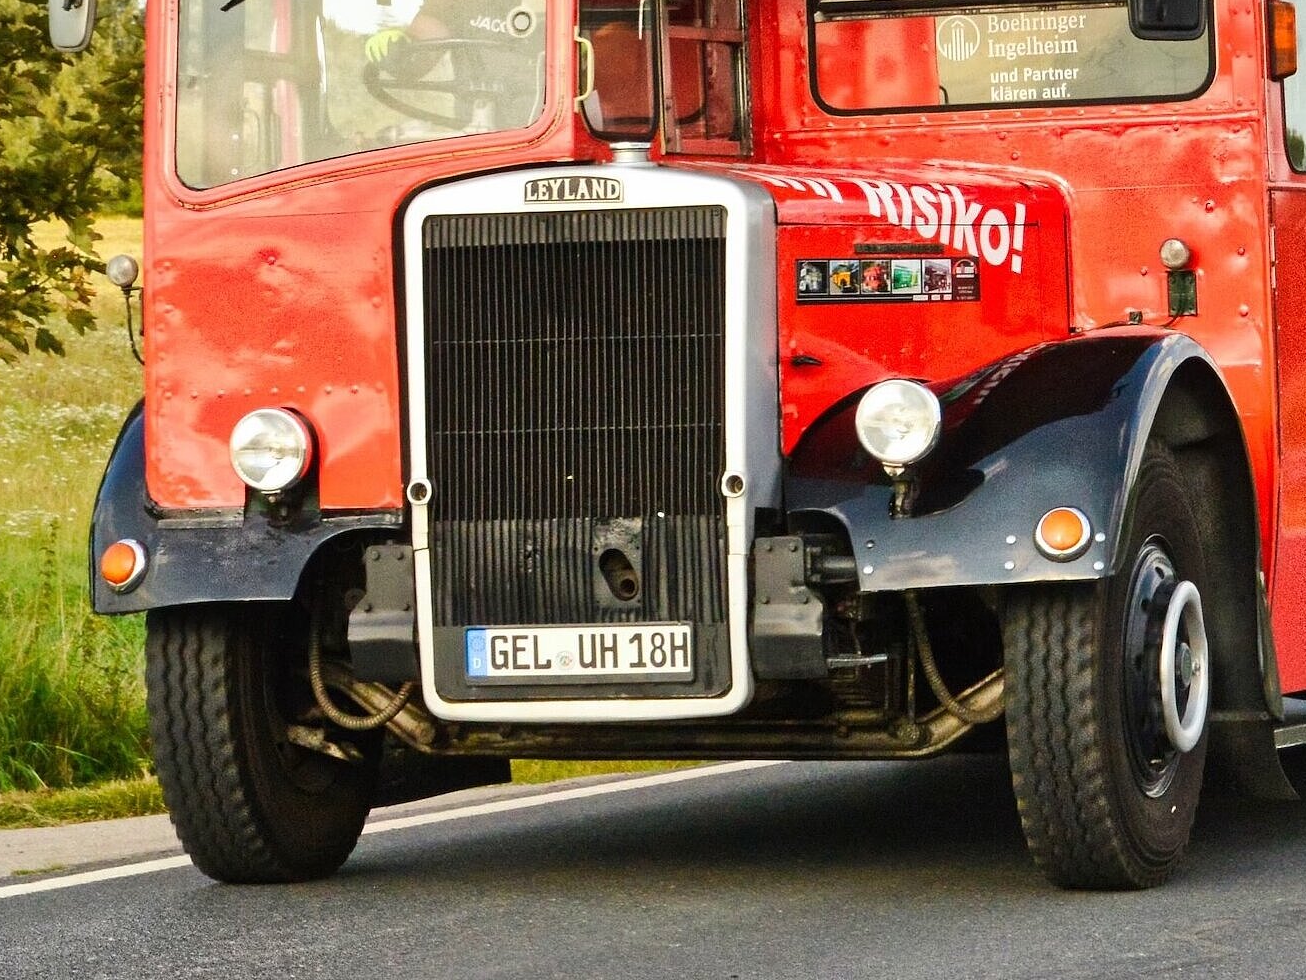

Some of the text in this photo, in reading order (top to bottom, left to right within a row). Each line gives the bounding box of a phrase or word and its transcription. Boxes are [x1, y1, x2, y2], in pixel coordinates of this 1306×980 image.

[987, 11, 1087, 34] Boehringer
[987, 34, 1079, 61] Ingelheim
[990, 67, 1080, 84] und Partner
[990, 82, 1072, 102] klären auf.
[525, 178, 621, 201] LEYLAND
[853, 178, 1026, 275] Risiko!
[490, 631, 690, 670] GEL UH 18H
[473, 658, 482, 669] D
